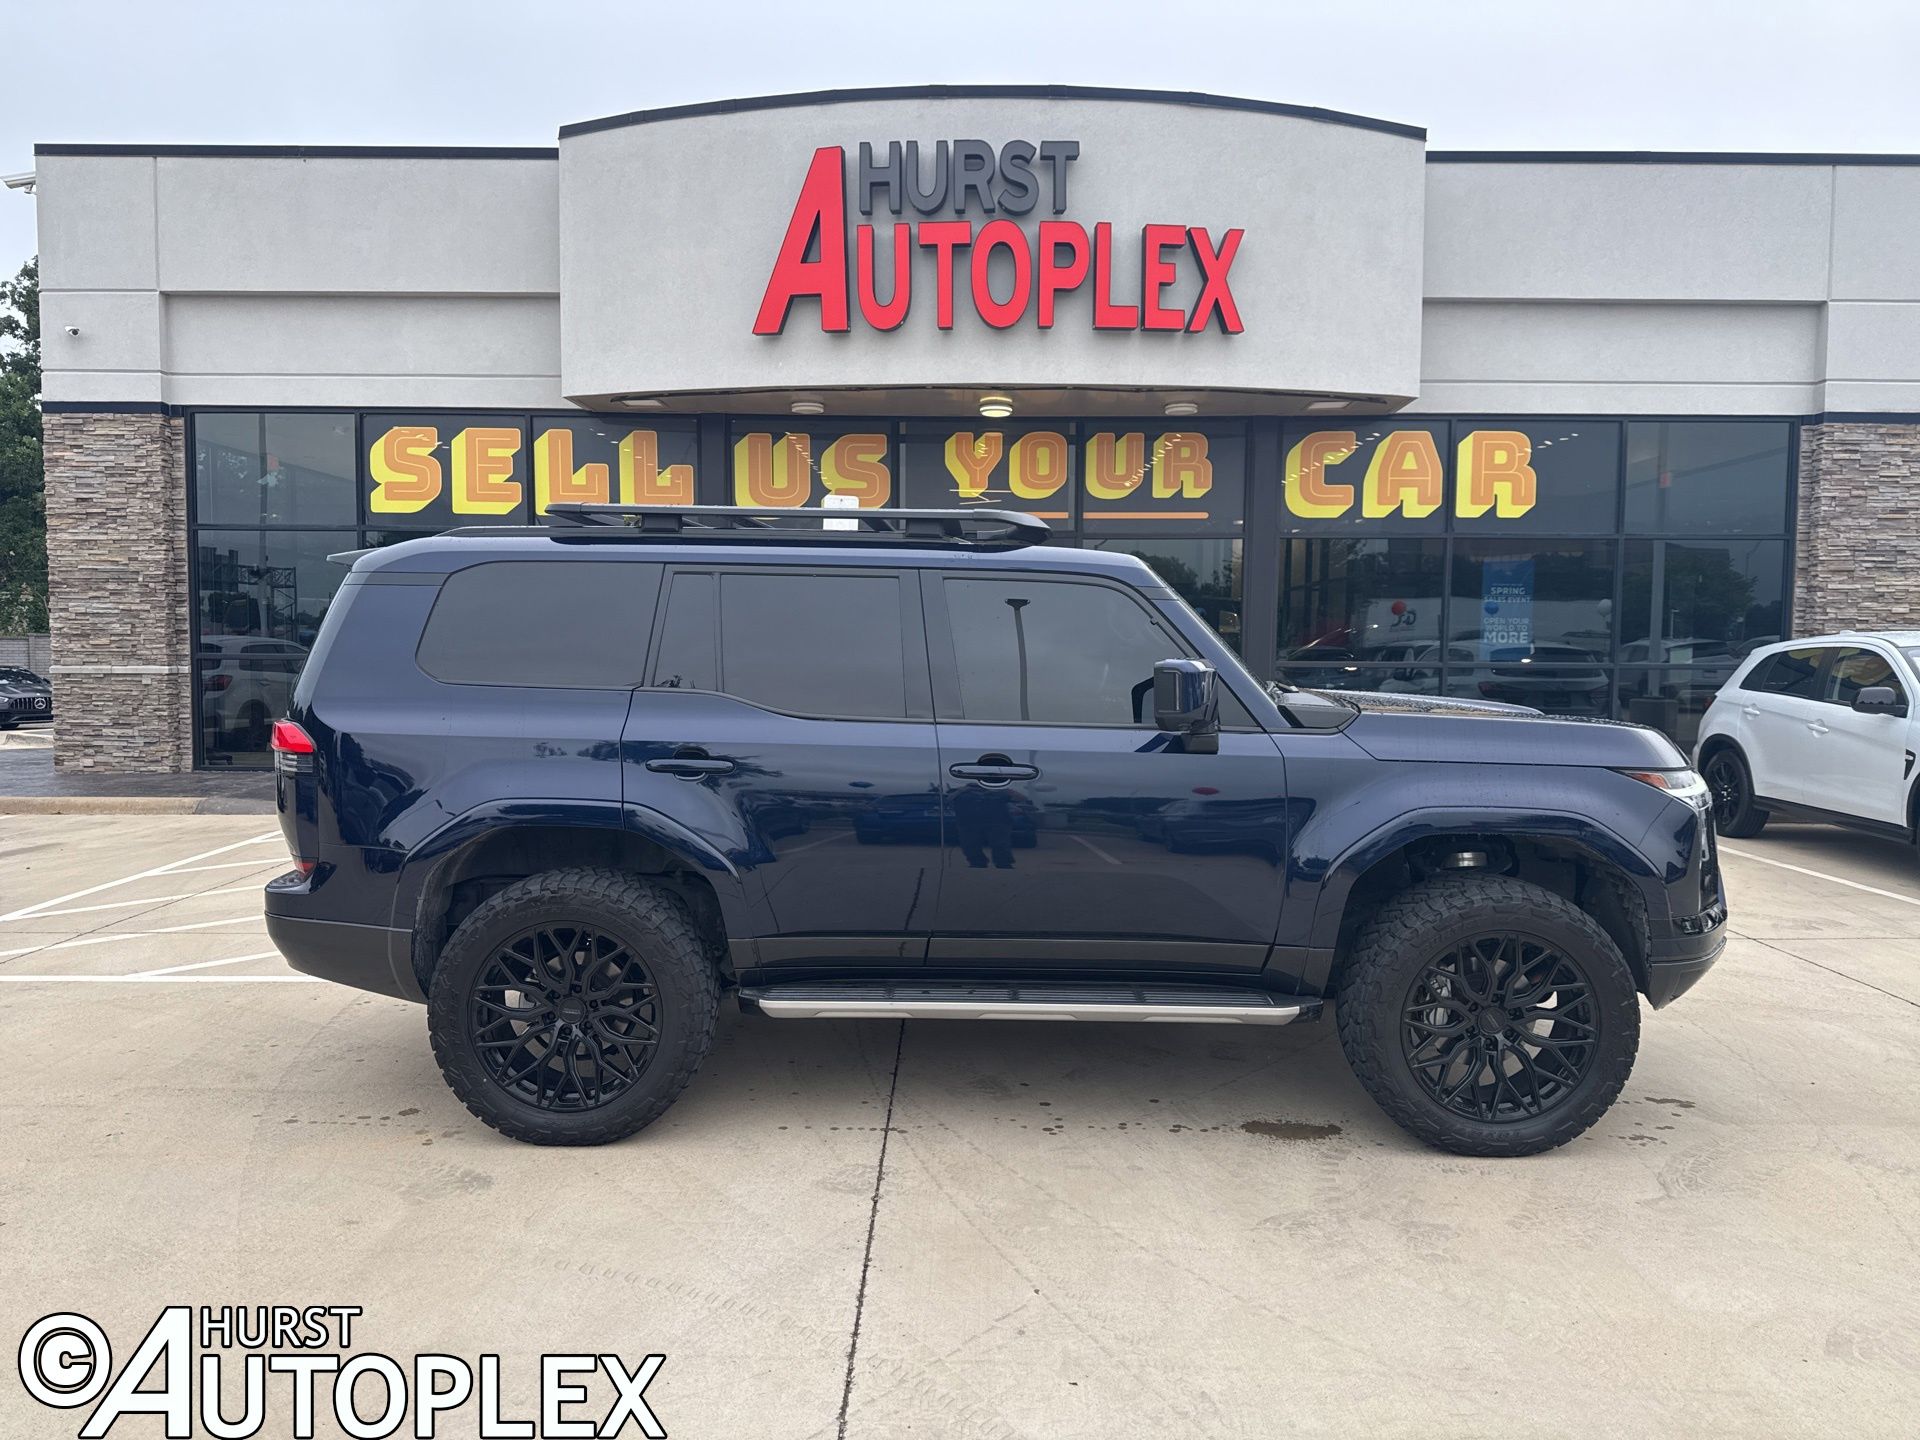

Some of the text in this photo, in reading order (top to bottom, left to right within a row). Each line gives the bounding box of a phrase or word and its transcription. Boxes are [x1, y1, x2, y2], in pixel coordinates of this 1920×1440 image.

[859, 139, 1080, 216] HURST
[752, 145, 1245, 335] AUTOPLEX
[370, 426, 1537, 519] SELL US YOUR CAR
[1490, 586, 1526, 595] SPRING
[1483, 617, 1506, 625] OPEN
[1483, 631, 1529, 644] MORE
